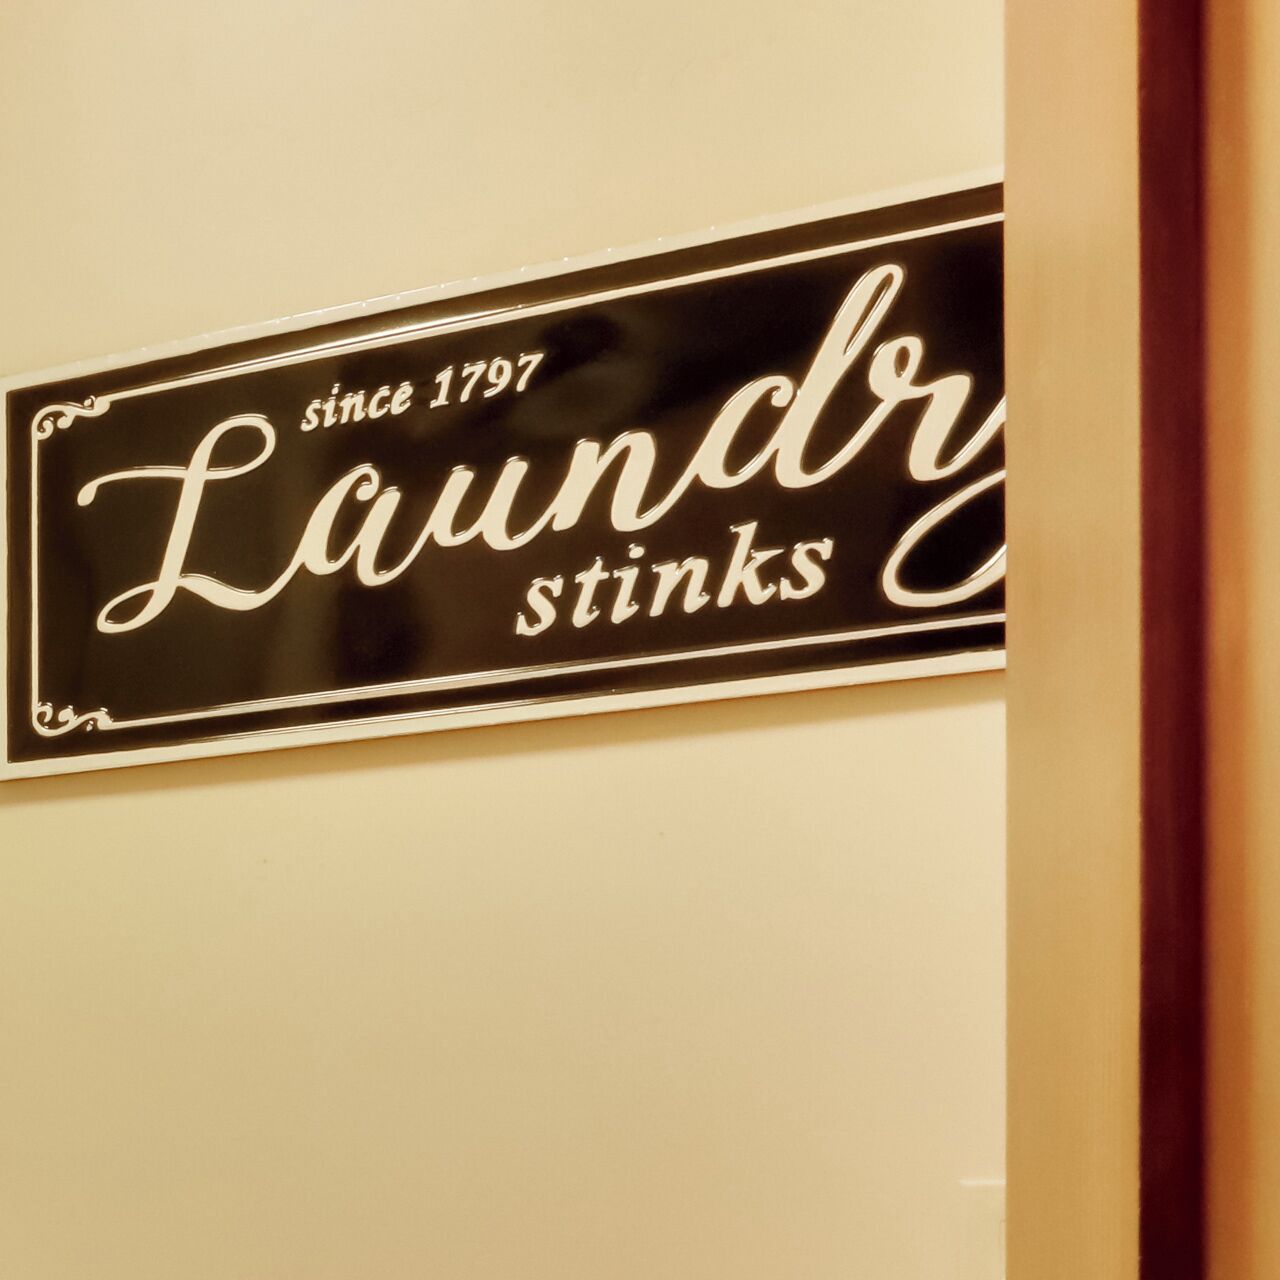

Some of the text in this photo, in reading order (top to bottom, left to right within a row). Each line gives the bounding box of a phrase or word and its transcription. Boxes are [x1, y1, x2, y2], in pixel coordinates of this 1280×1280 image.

[299, 351, 545, 433] since 1797
[515, 520, 835, 638] stinks
